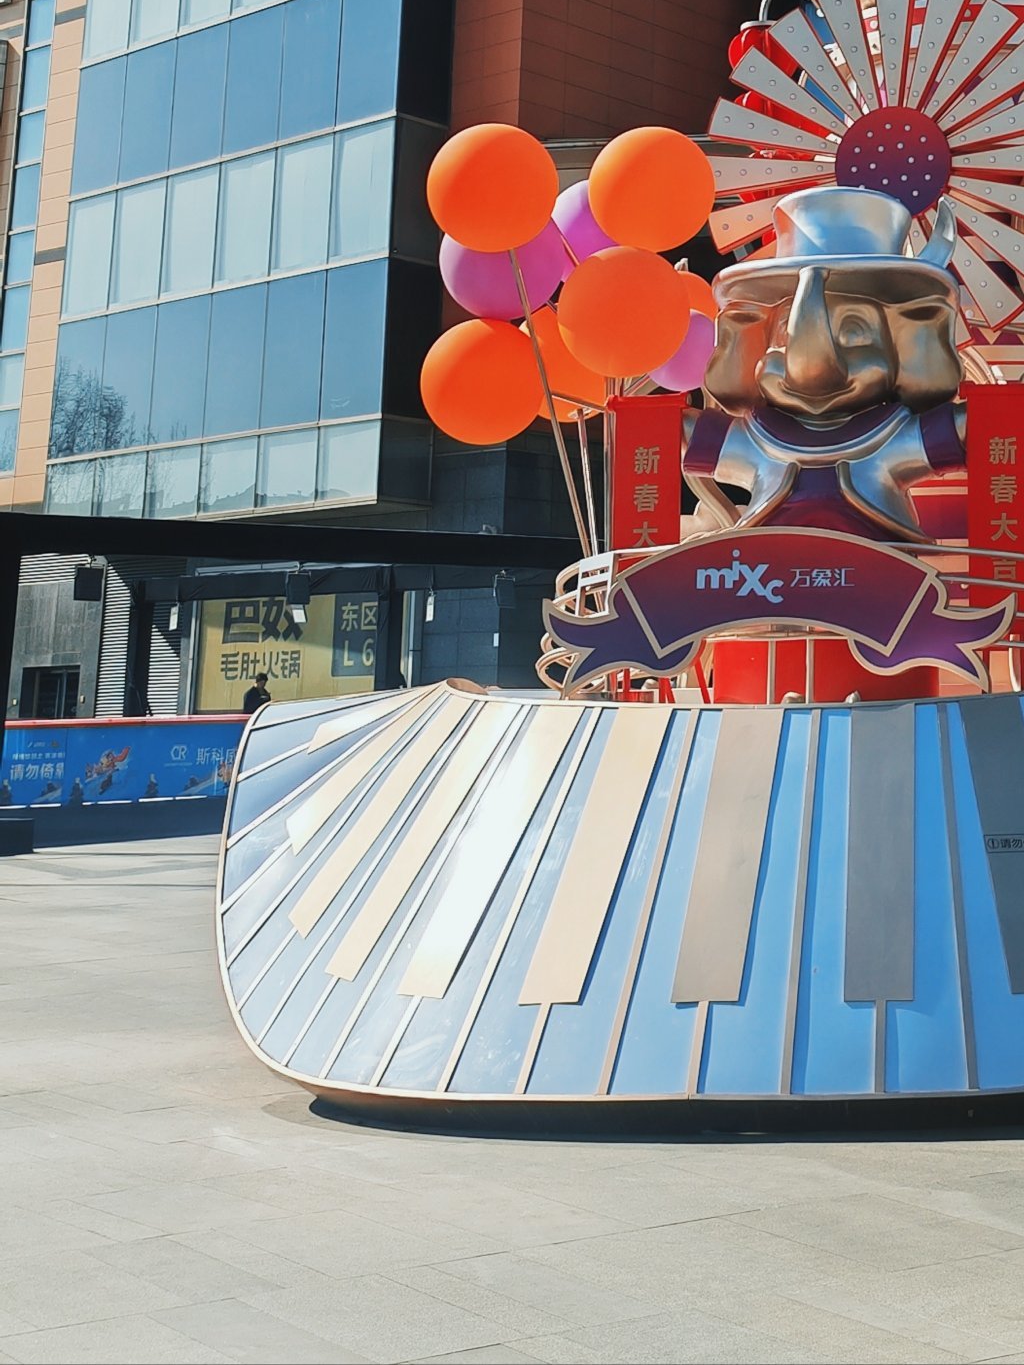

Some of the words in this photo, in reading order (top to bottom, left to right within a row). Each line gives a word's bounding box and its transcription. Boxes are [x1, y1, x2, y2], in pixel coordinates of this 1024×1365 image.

[790, 567, 855, 588] 万象汇
[222, 599, 304, 644] 巴奴
[341, 601, 378, 631] 东区
[220, 650, 301, 681] 毛肚火锅
